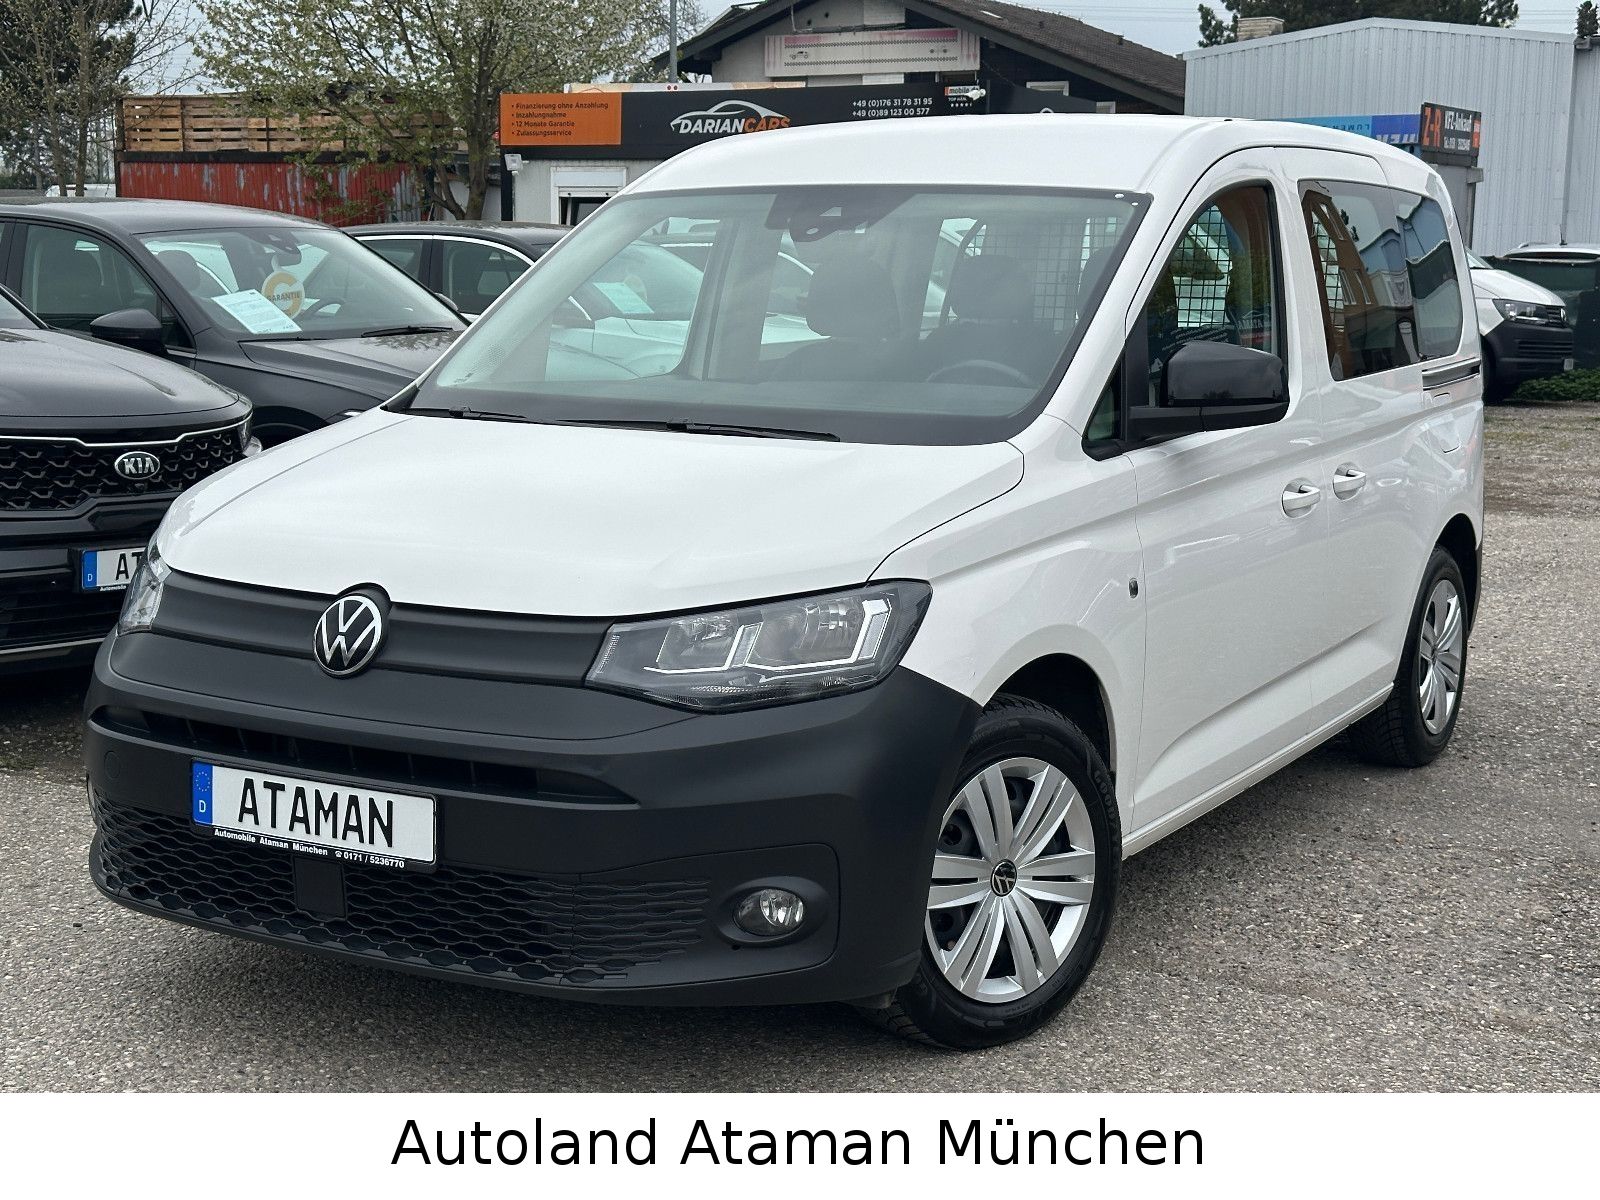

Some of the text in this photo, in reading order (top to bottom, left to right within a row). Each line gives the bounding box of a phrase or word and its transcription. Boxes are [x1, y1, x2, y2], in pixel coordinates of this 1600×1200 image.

[515, 102, 556, 111] Finanzierung
[575, 101, 609, 110] Anzahlung
[868, 99, 891, 107] (0)176
[868, 109, 888, 117] (0)89
[679, 116, 791, 134] DARIANCARS
[516, 129, 572, 137] Zulassungsservice
[122, 456, 155, 475] KIA
[115, 551, 144, 581] AT
[87, 573, 93, 582] D
[198, 799, 206, 813] D
[238, 777, 393, 848] ATAMAN
[214, 828, 256, 843] Automobile
[259, 836, 289, 849] Ataman
[292, 842, 328, 856] München
[343, 851, 363, 862] 0171
[369, 855, 405, 869] 5236770
